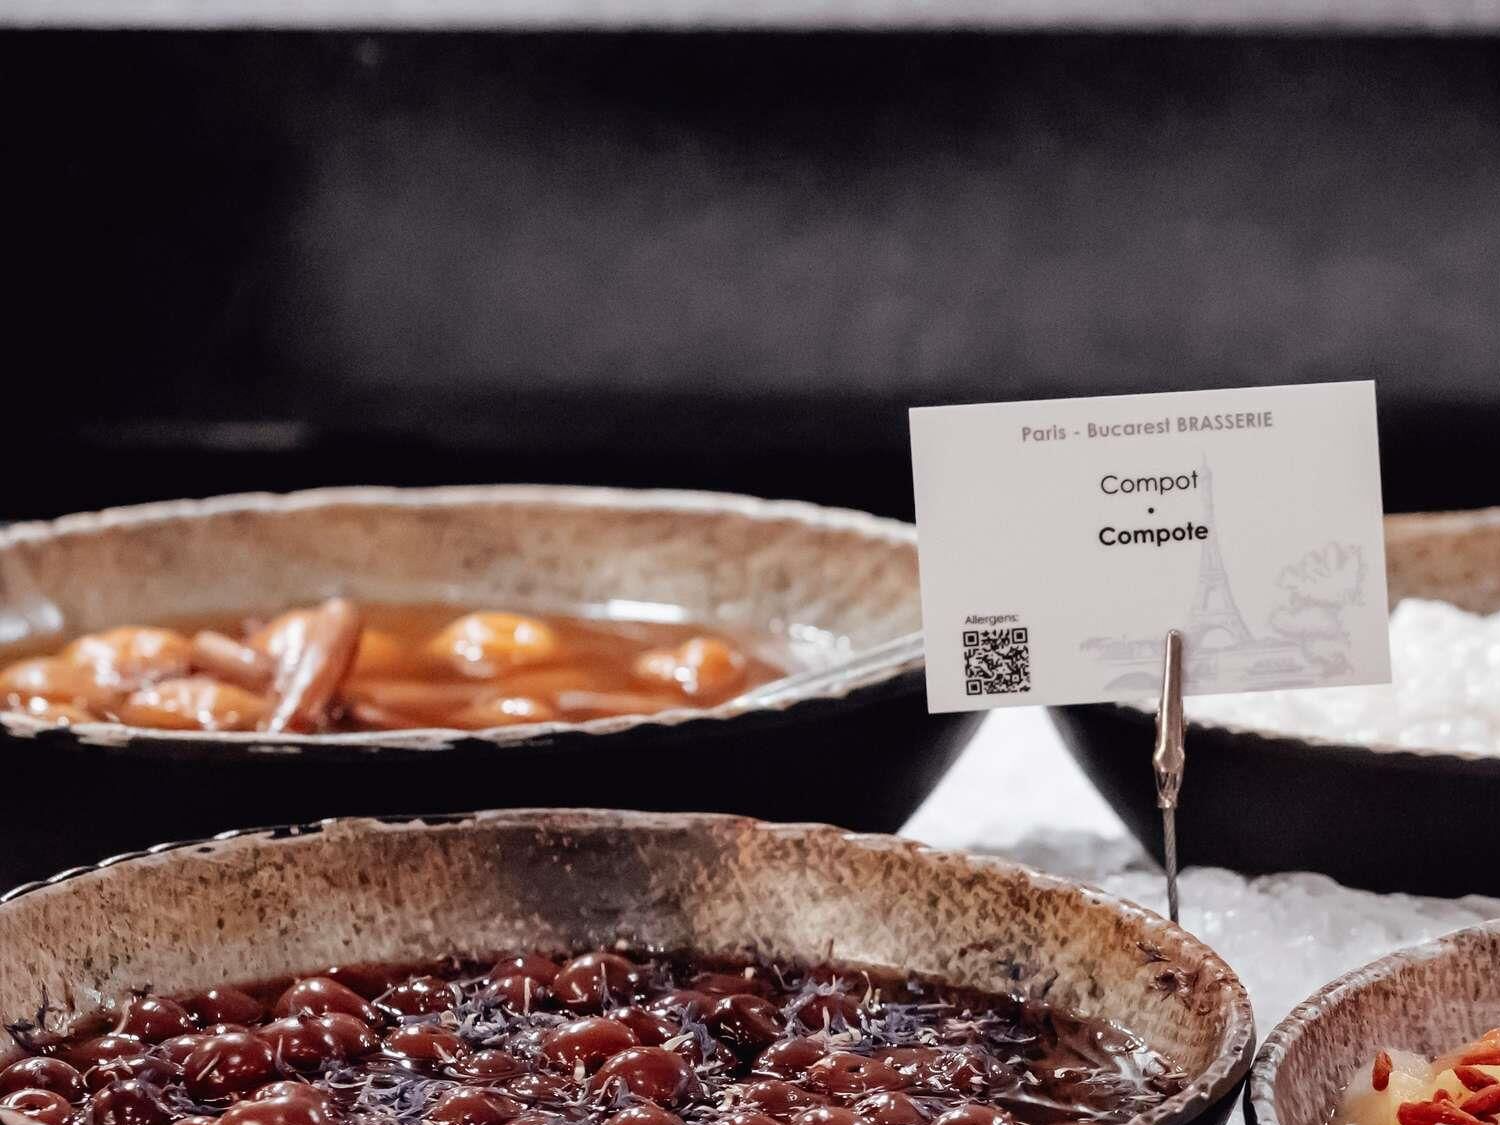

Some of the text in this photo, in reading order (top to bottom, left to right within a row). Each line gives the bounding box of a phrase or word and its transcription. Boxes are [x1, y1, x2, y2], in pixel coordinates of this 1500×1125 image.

[1021, 423, 1067, 442] Paris
[1087, 416, 1171, 439] Bucarest
[1177, 410, 1273, 433] BRASSERIE
[1099, 469, 1199, 496] Compot
[1097, 520, 1210, 548] Compote
